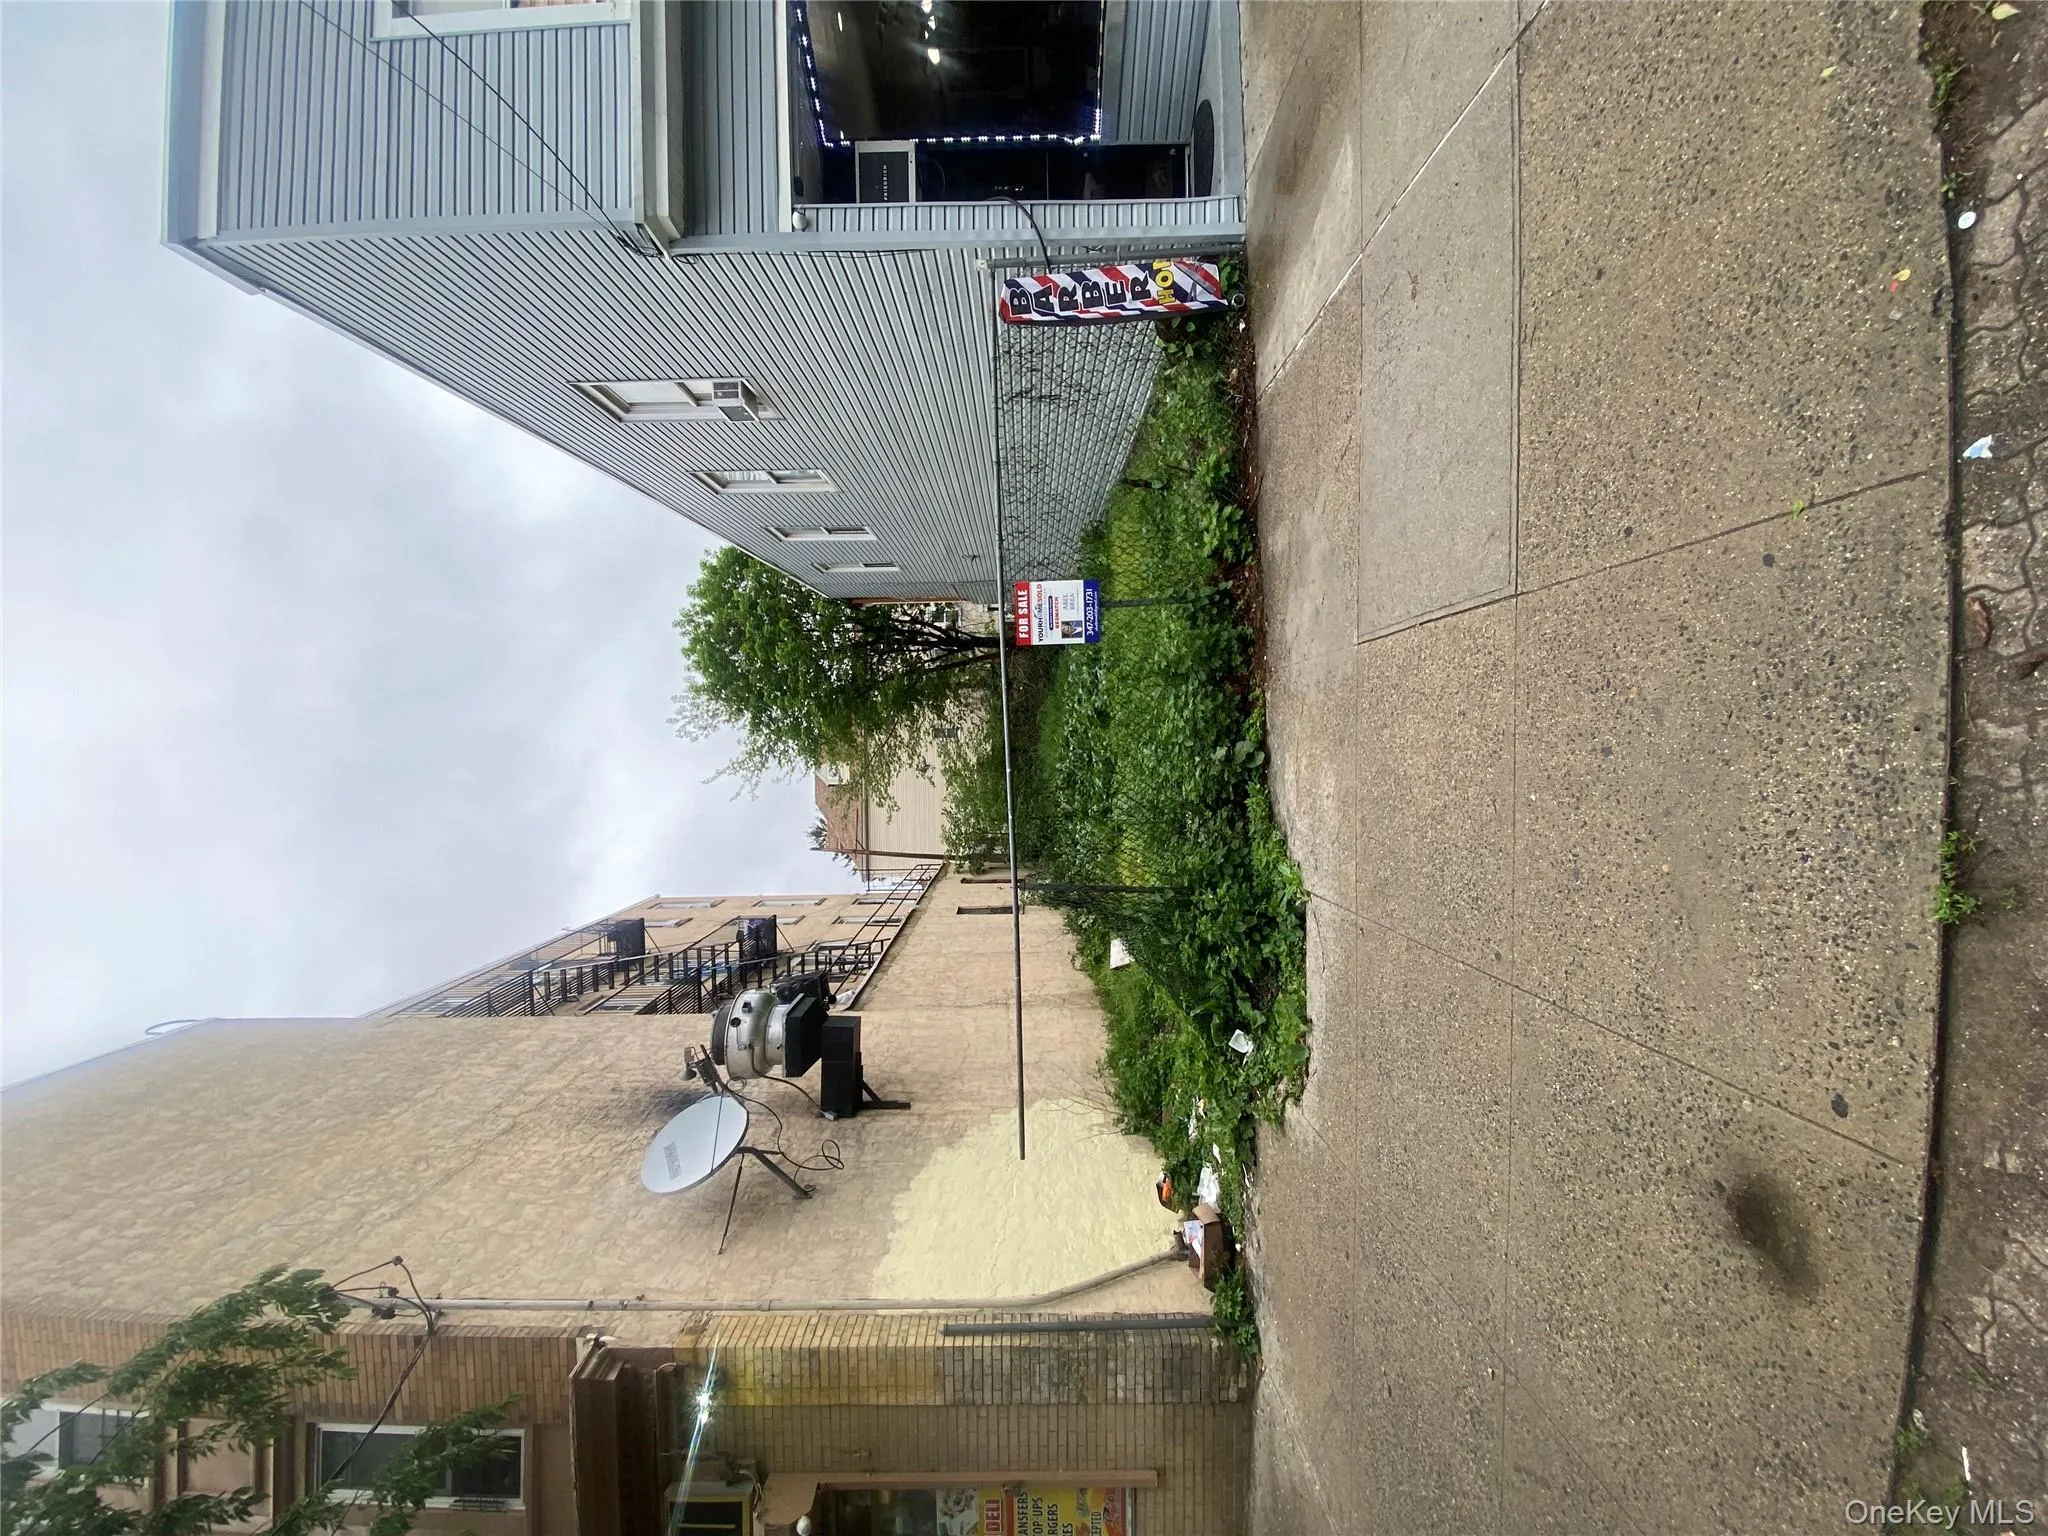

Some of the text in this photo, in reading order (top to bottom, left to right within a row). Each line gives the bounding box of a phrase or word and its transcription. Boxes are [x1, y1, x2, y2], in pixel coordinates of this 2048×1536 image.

[1009, 271, 1152, 316] BARBER
[1017, 589, 1029, 638] FOR SALE
[1085, 588, 1094, 636] 347-203-1731
[985, 1499, 1002, 1532] DELI
[1047, 1503, 1058, 1536] RGERS
